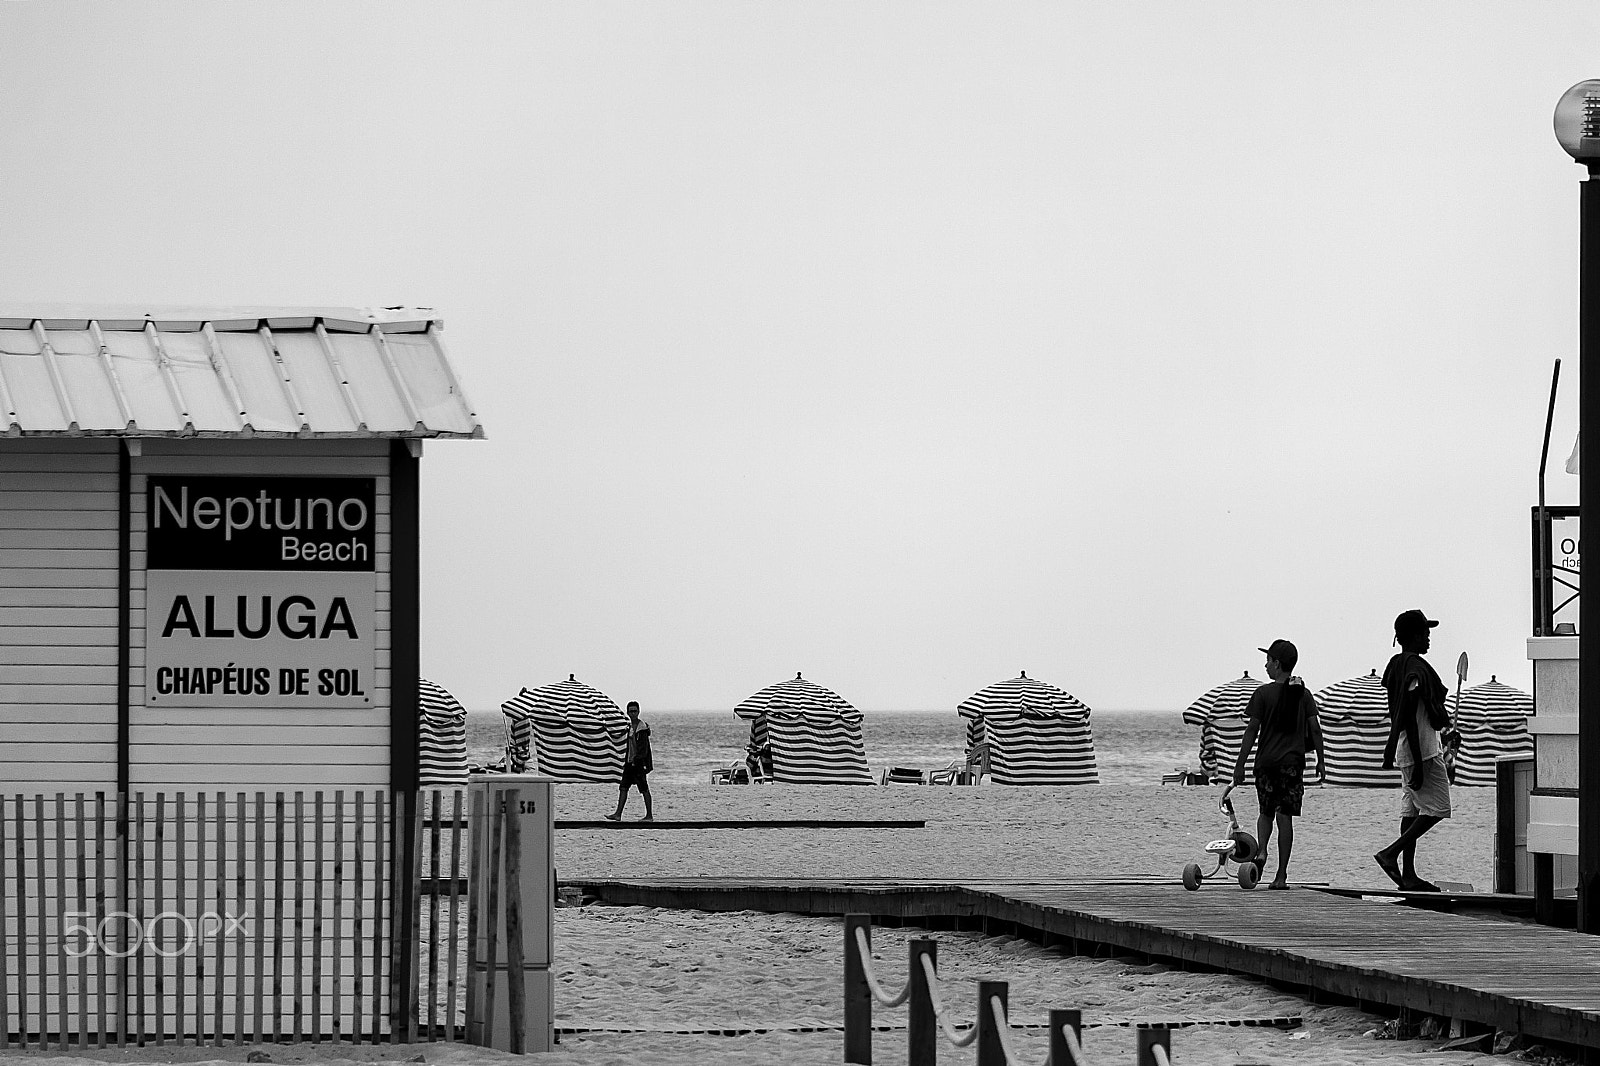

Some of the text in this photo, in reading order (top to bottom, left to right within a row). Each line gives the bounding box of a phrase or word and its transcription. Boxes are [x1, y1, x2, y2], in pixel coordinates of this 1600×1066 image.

[154, 486, 368, 541] Neptuno
[281, 536, 367, 561] Beach
[161, 594, 359, 639] ALUGA
[156, 662, 365, 697] CHAPÉUS DE SOL
